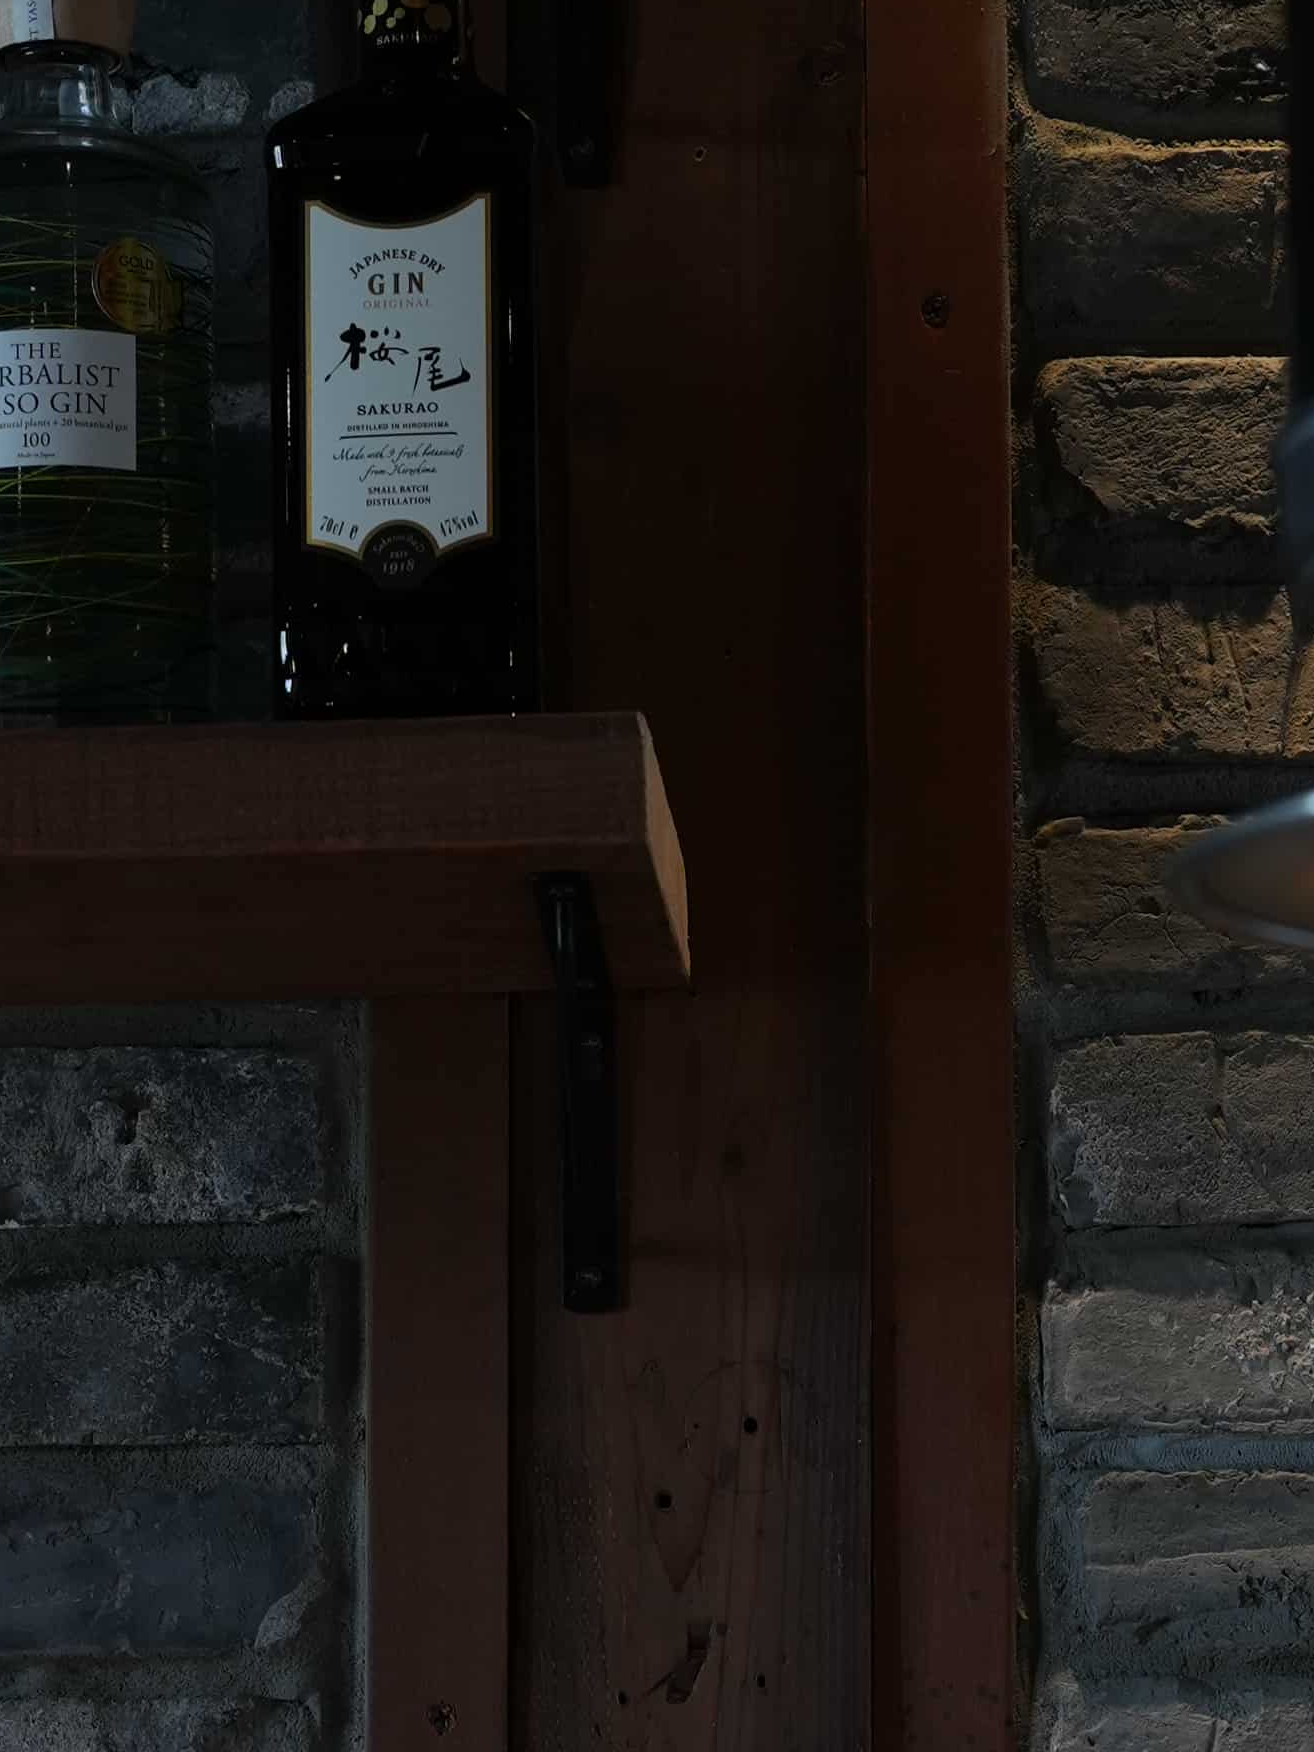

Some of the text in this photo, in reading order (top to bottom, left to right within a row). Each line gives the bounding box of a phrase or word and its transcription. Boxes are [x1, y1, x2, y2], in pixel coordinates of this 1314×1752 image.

[348, 248, 446, 280] JAPANESE DRY
[367, 271, 425, 296] GIN
[362, 298, 432, 310] ORIGINAL
[10, 342, 62, 360] THE
[324, 322, 471, 397] 桜尾
[50, 391, 107, 415] GIN
[356, 401, 439, 416] SAKURAO
[22, 432, 51, 448] 100
[368, 484, 429, 495] SMALL BATCH
[365, 496, 431, 507] DISTILLATION
[319, 514, 345, 536] 70cl
